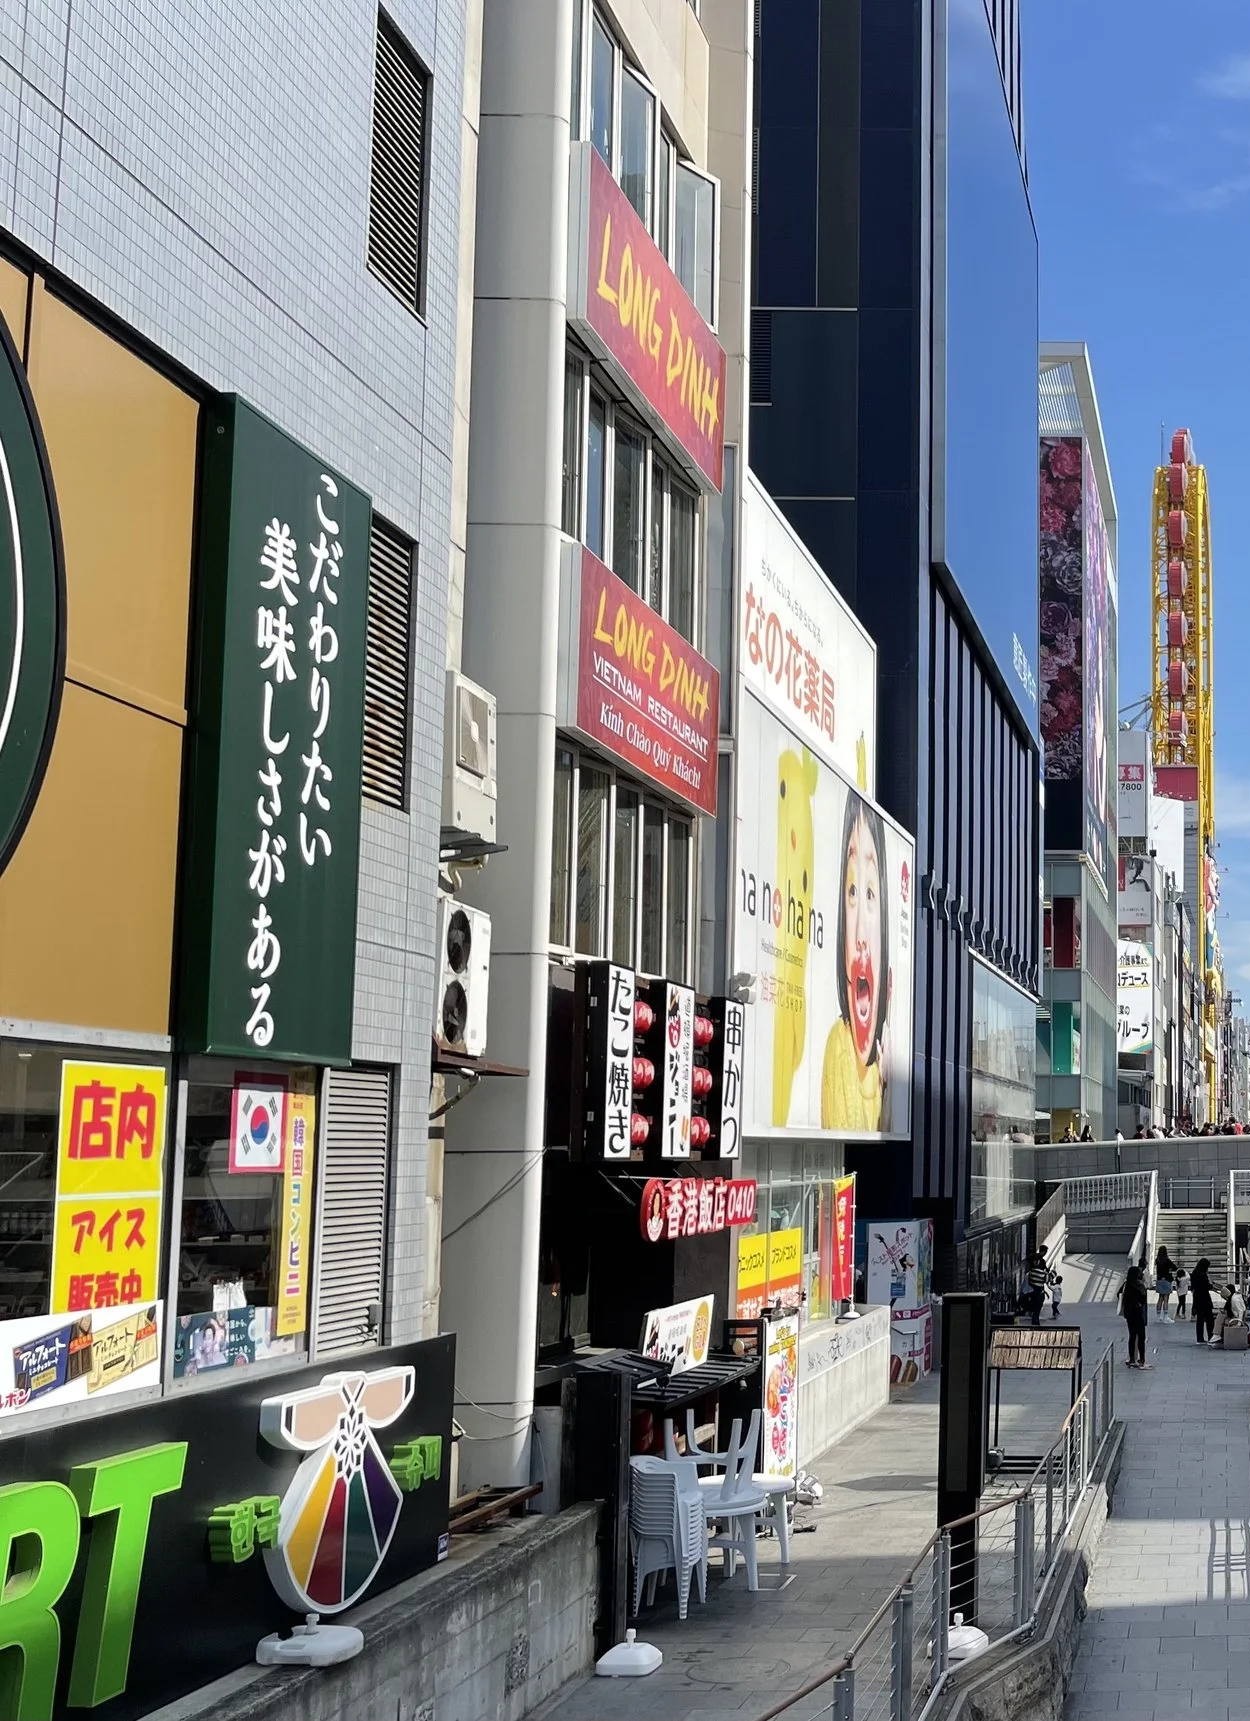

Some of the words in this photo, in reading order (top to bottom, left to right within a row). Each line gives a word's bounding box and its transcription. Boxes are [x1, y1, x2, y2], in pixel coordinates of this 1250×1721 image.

[597, 213, 662, 364] LONG
[666, 308, 720, 442] DINH
[299, 473, 343, 867] こだわりたい
[593, 650, 642, 706] VIETNAM
[648, 695, 708, 756] RESTAURANT
[594, 587, 656, 682] LONG
[659, 641, 710, 724] DINH
[745, 582, 835, 744] なの花薬局
[245, 517, 299, 1047] 美味しさがある
[600, 702, 624, 738] Kính
[626, 720, 651, 756] Chào
[652, 741, 672, 773] Quý
[672, 754, 701, 790] Khách!
[608, 970, 632, 1154] たこ焼き
[723, 1005, 741, 1155] 串かつ
[68, 1080, 156, 1161] 店内
[71, 1207, 147, 1255] アイス
[286, 1116, 306, 1296] 韓国コンビニ
[666, 1182, 727, 1240] 香港飯店
[728, 1183, 755, 1221] 0410
[68, 1268, 142, 1312] 販売中
[93, 1327, 133, 1355] アルフォート
[20, 1337, 66, 1371] アルフォート
[229, 1495, 281, 1563] 한국
